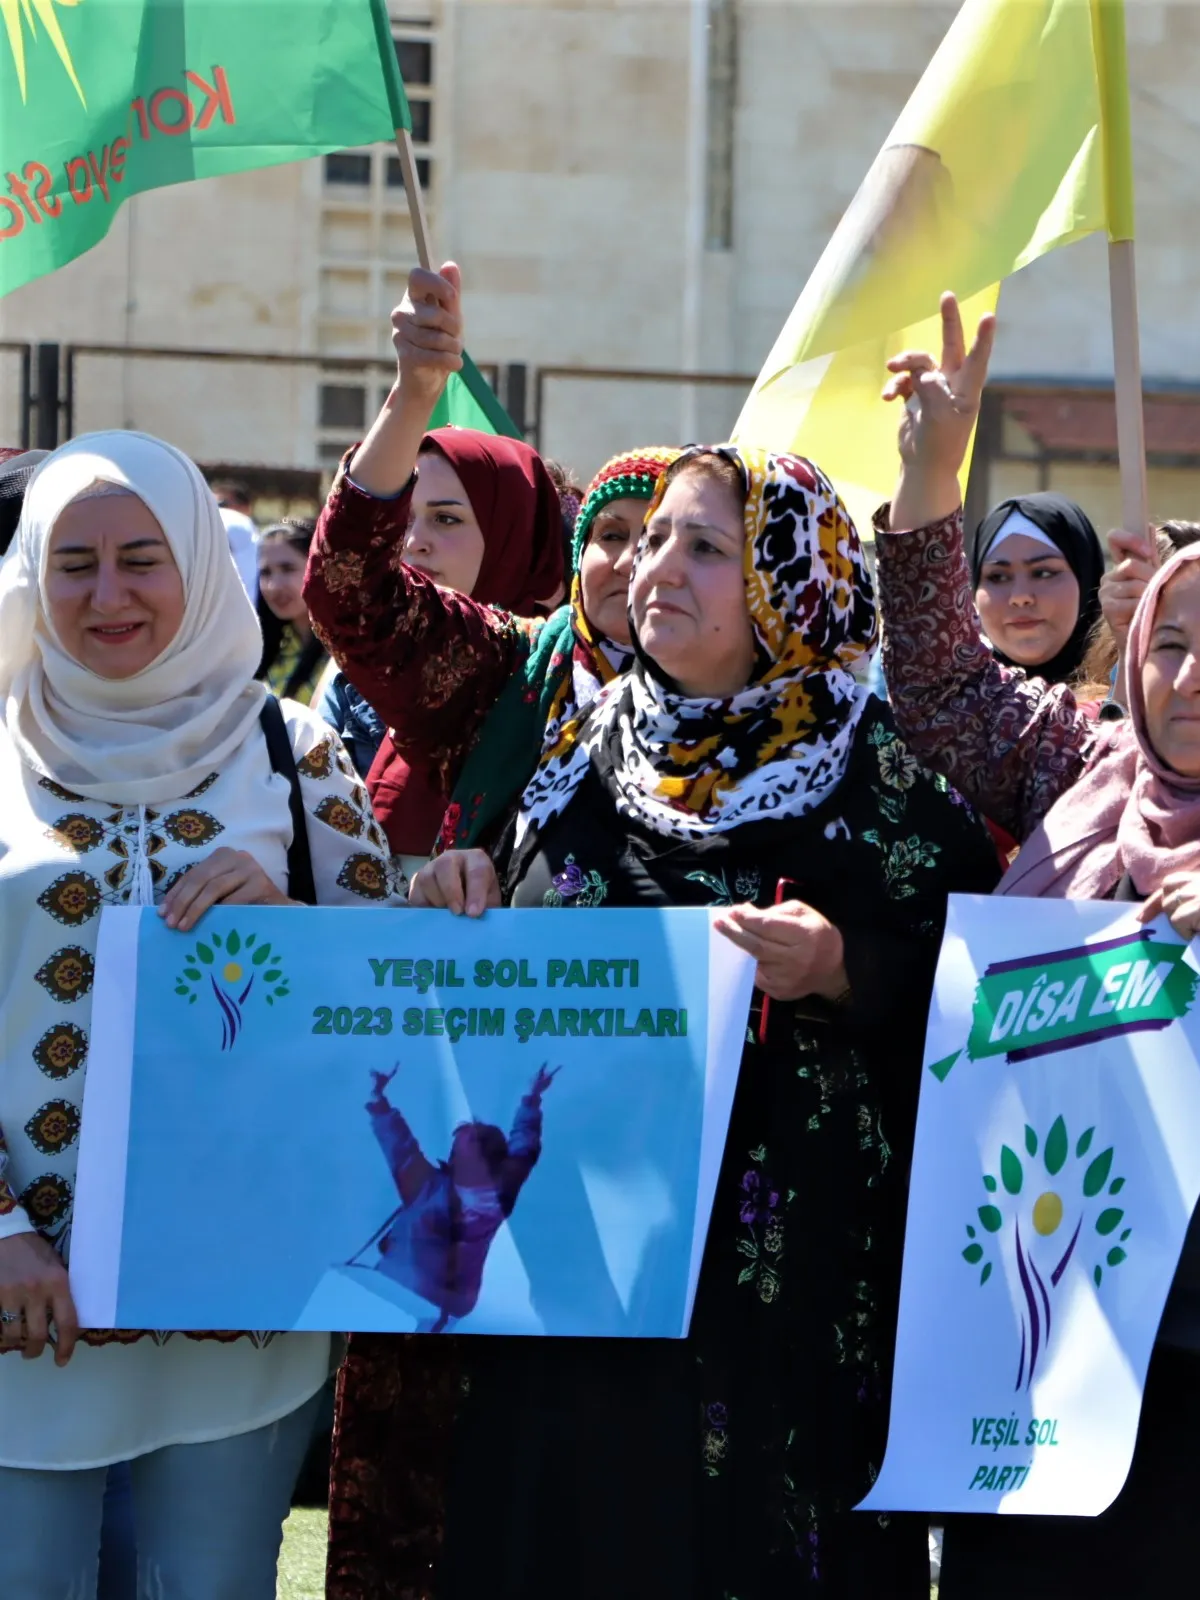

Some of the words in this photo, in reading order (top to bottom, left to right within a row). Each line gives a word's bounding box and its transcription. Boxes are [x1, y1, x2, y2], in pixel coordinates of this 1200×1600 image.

[472, 958, 538, 988] SOL
[546, 958, 640, 988] PARTI
[988, 972, 1088, 1043] DÎSA
[1089, 959, 1175, 1017] EM
[311, 1006, 394, 1036] 2023
[401, 1008, 506, 1043] SEÇIM
[513, 1008, 688, 1043] ŞARKILARI
[970, 1411, 1020, 1452] YEŞİL
[1024, 1417, 1059, 1446] SOL
[968, 1460, 1033, 1491] PARTİ
